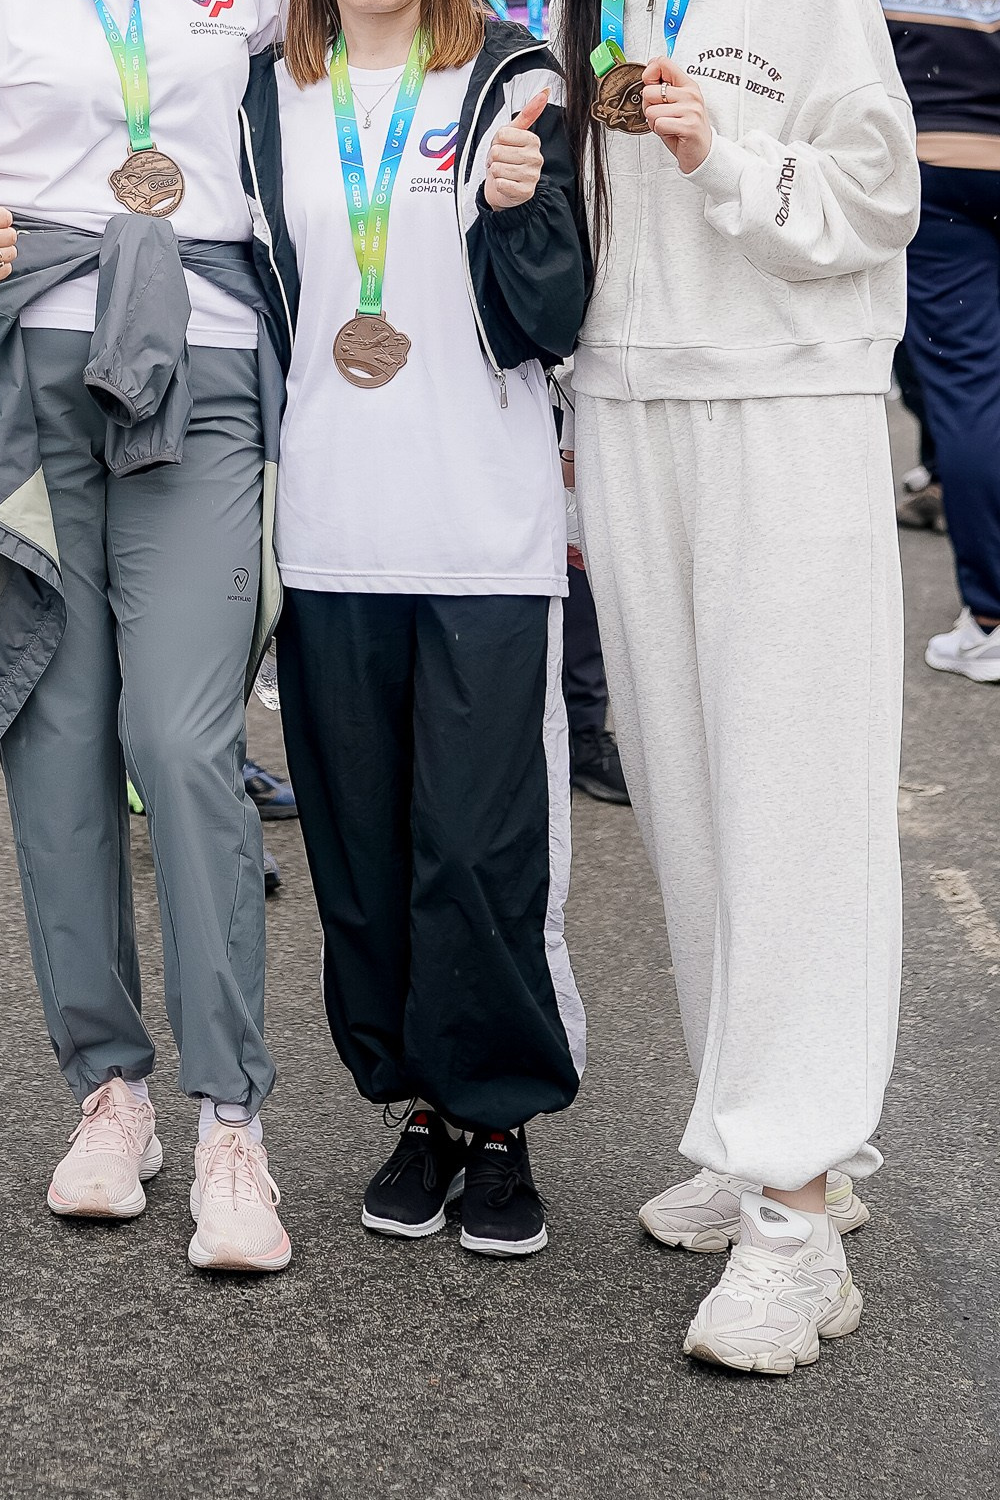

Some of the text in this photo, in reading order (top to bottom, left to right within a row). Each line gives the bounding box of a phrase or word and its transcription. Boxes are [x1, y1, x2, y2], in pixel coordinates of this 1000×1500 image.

[767, 67, 783, 83] OF
[380, 166, 392, 192] СБЕР
[351, 184, 362, 209] СБЕР
[409, 185, 437, 194] ФОНД
